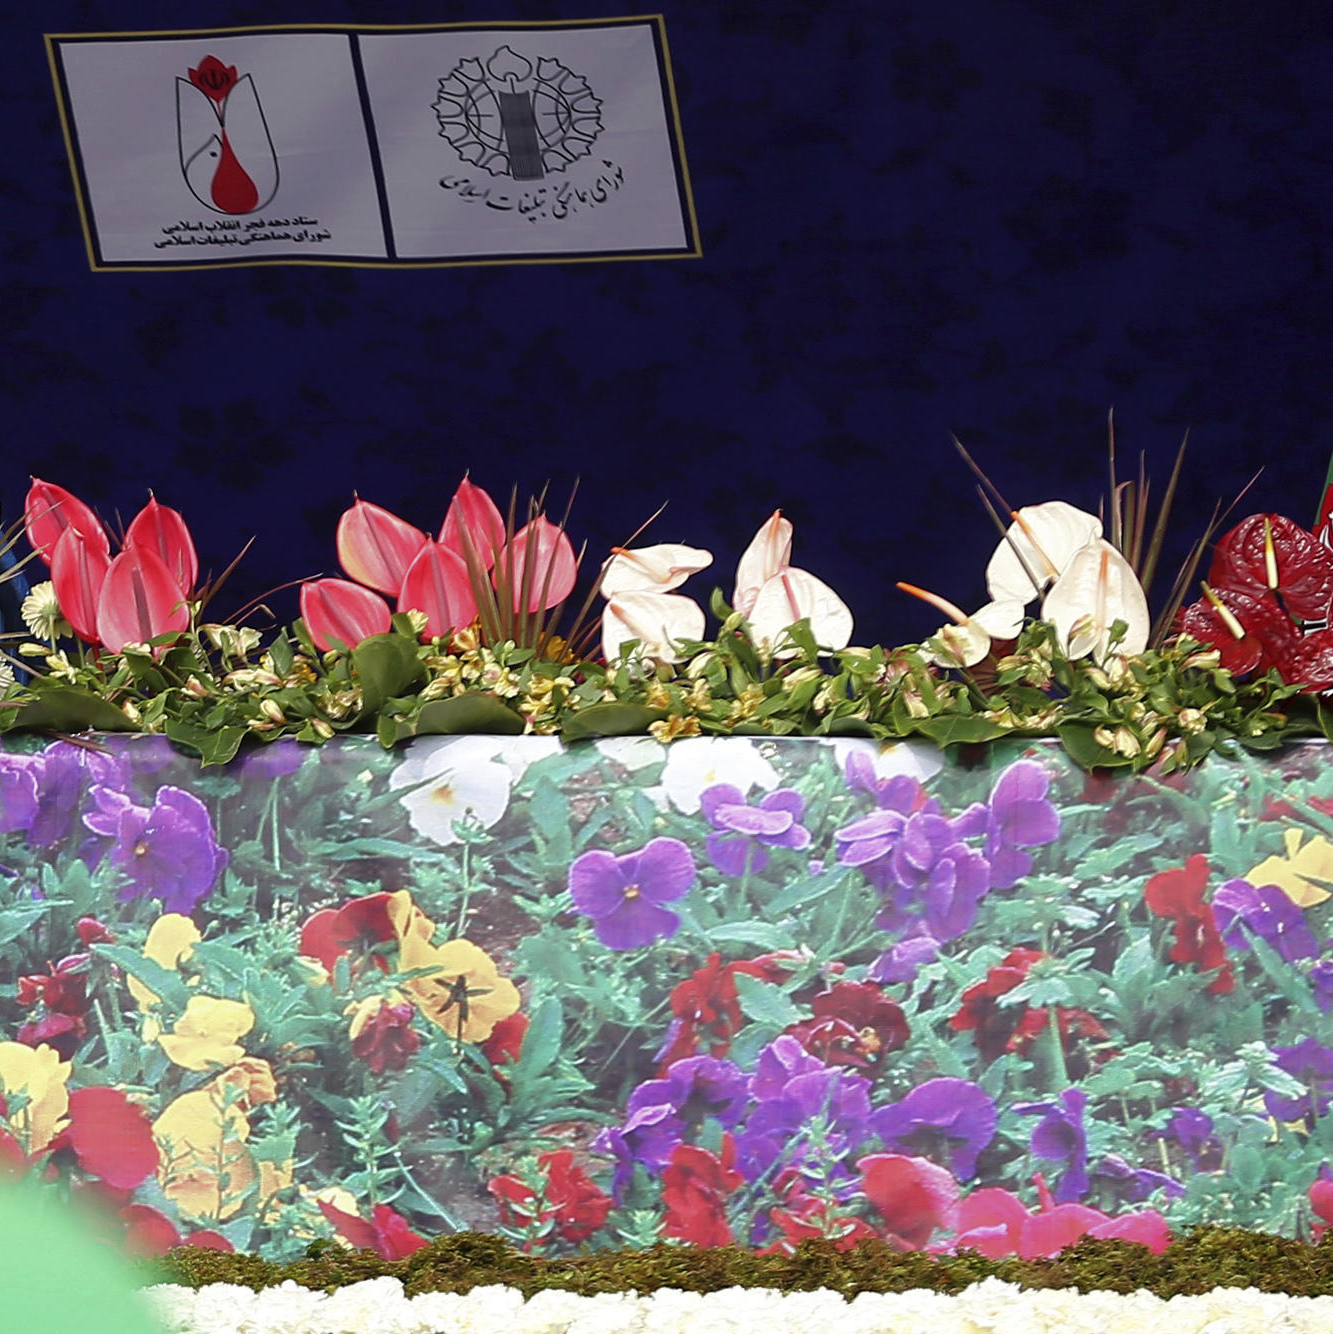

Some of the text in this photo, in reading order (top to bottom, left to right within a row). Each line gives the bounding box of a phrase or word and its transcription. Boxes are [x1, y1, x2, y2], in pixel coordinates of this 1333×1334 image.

[439, 175, 491, 203] اسلامی
[590, 160, 624, 203] شورای
[486, 188, 547, 224] تبلیغات
[154, 229, 332, 249] شورای هماهنگی تبلیغات اسلامی
[162, 216, 319, 234] ستاد دهه فجر انقلاب اسلامی
